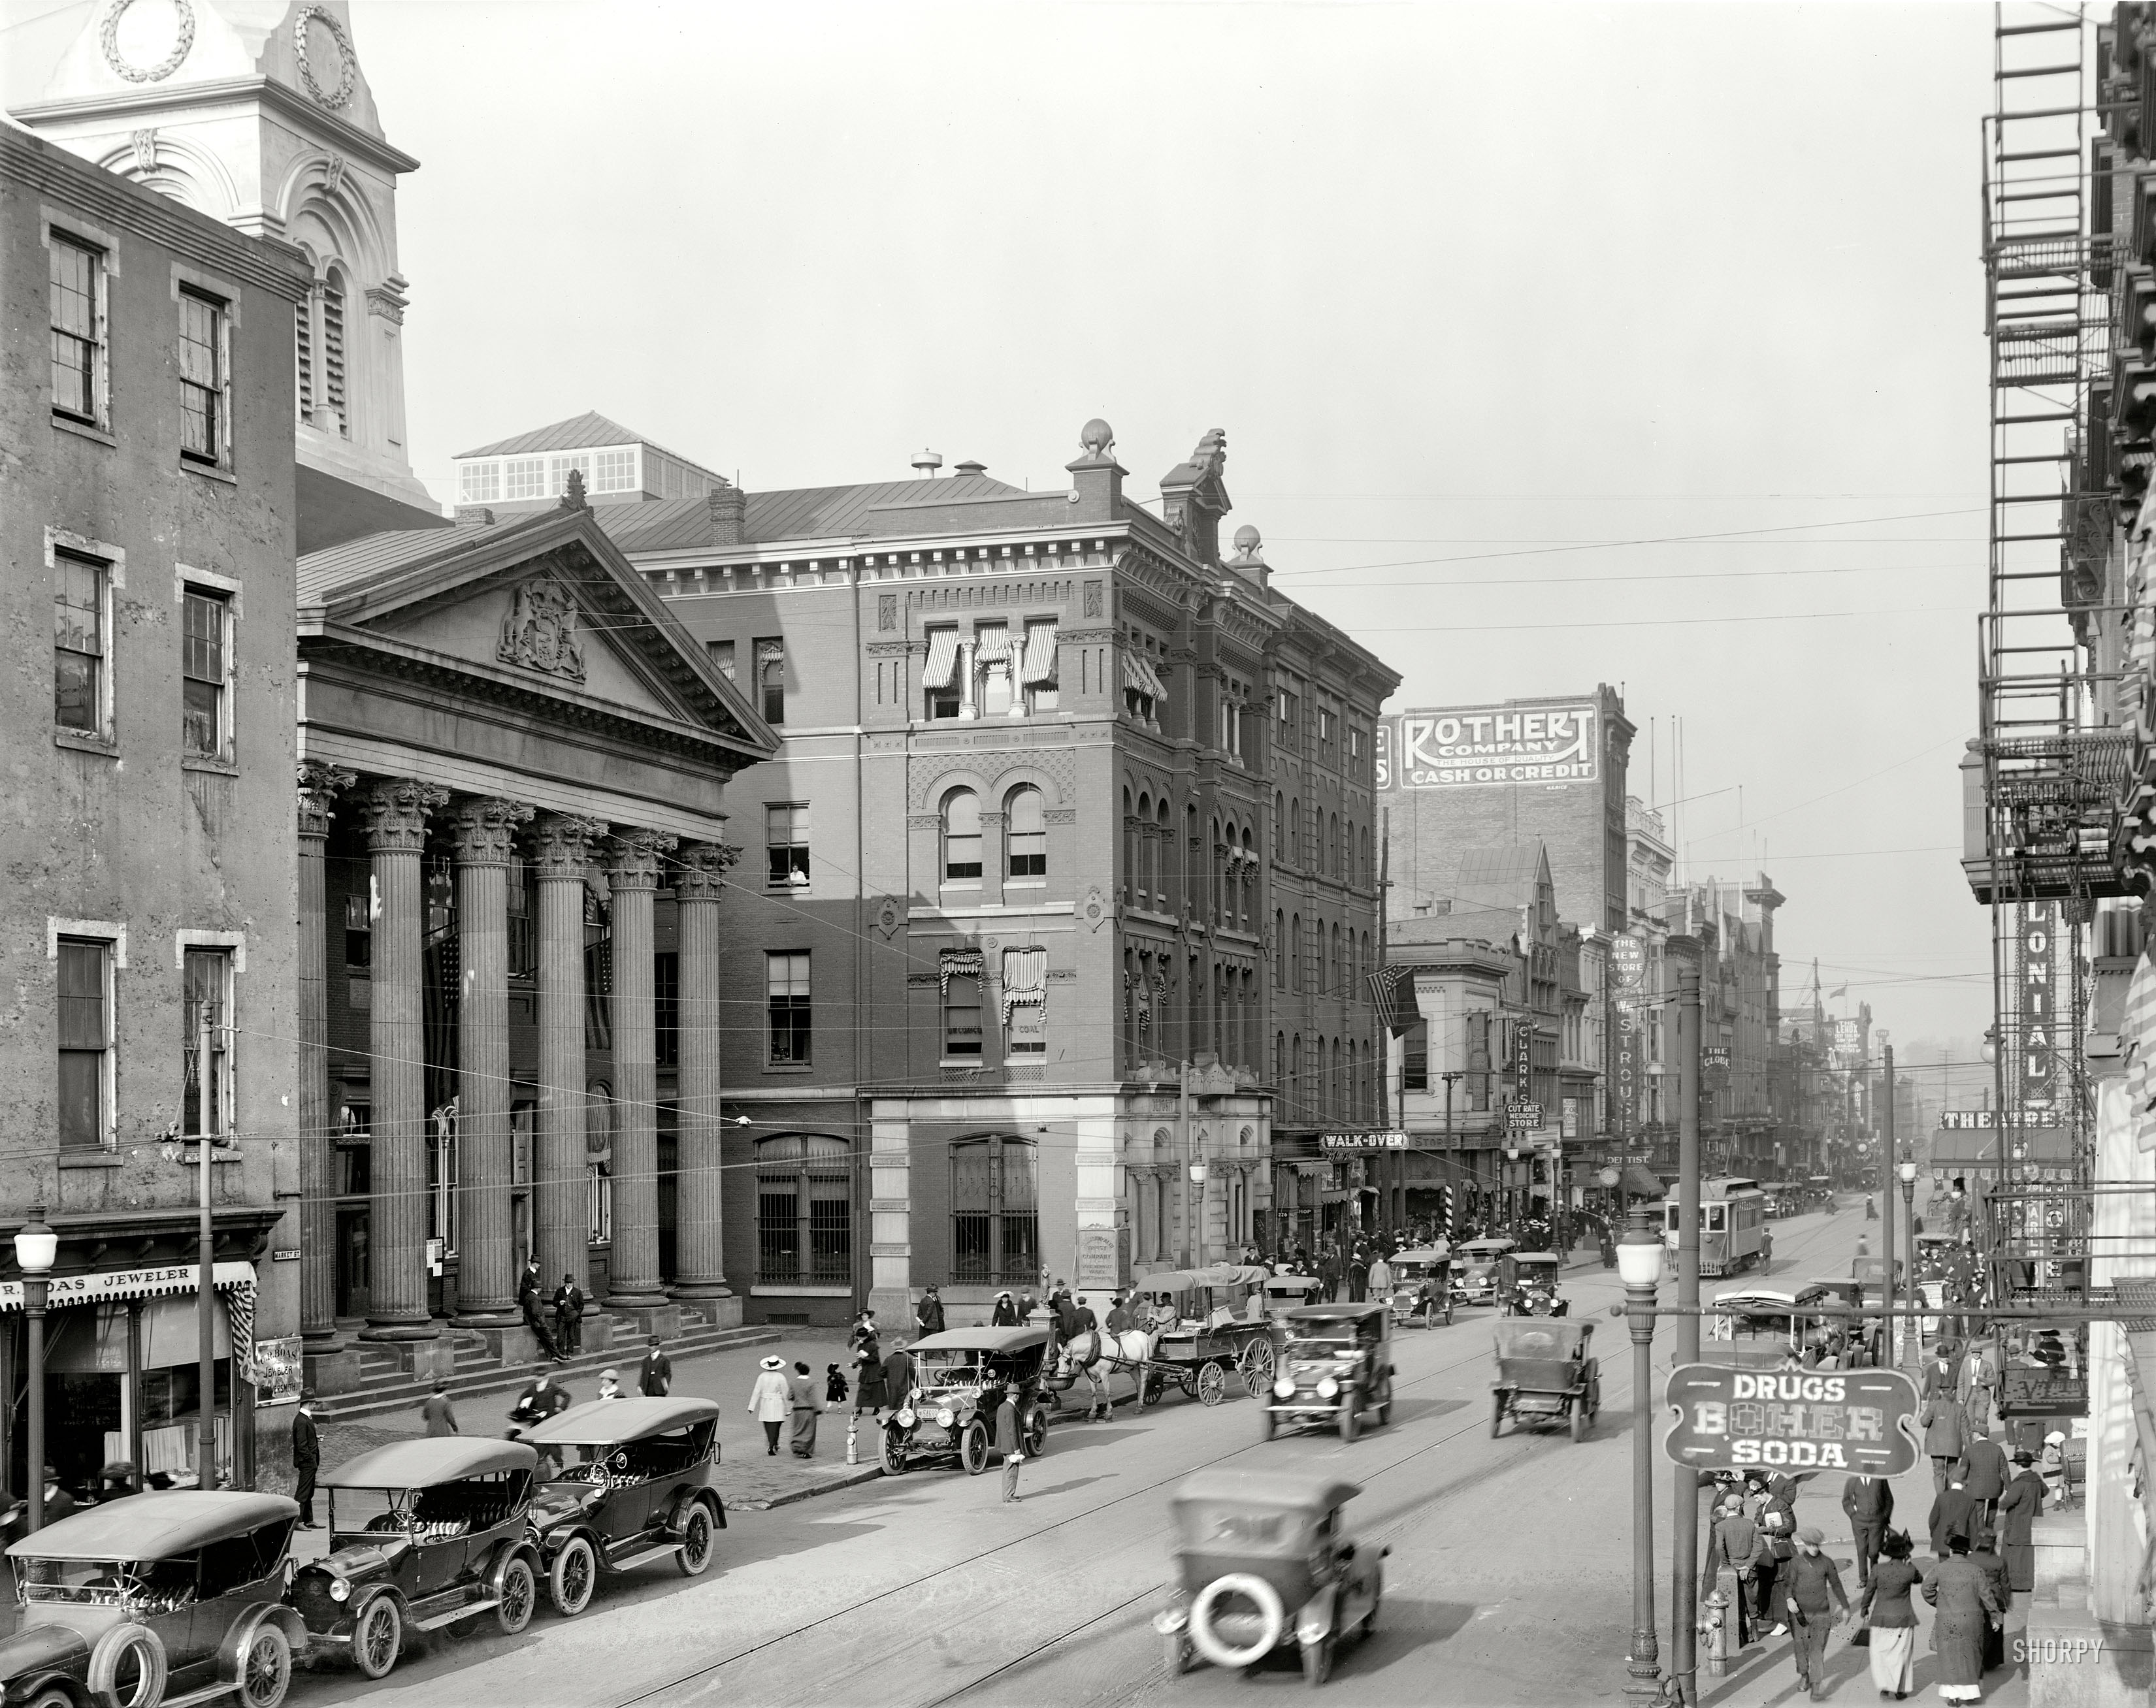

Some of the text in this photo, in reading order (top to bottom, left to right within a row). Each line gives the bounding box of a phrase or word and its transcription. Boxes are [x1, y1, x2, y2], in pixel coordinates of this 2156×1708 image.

[1405, 710, 1594, 769] ROTHERT
[1438, 741, 1559, 756] COMPANY
[1411, 763, 1592, 784] CASH OR CREDIT
[2027, 901, 2048, 1077] LONIAL
[1837, 1025, 1857, 1033] LENOX
[1519, 1026, 1528, 1104] CLARK'S
[1704, 1055, 1731, 1070] GLOBE
[1620, 1019, 1632, 1132] STROUSE
[1509, 1119, 1539, 1127] STORE
[1944, 1111, 2056, 1129] THEATRE
[1326, 1135, 1403, 1147] WALK-OVER
[47, 1279, 85, 1292] OAS
[105, 1268, 189, 1286] JEWELER
[263, 1365, 293, 1378] JEWELER
[1733, 1374, 1846, 1402] DRUGS
[1732, 1440, 1848, 1468] SODA
